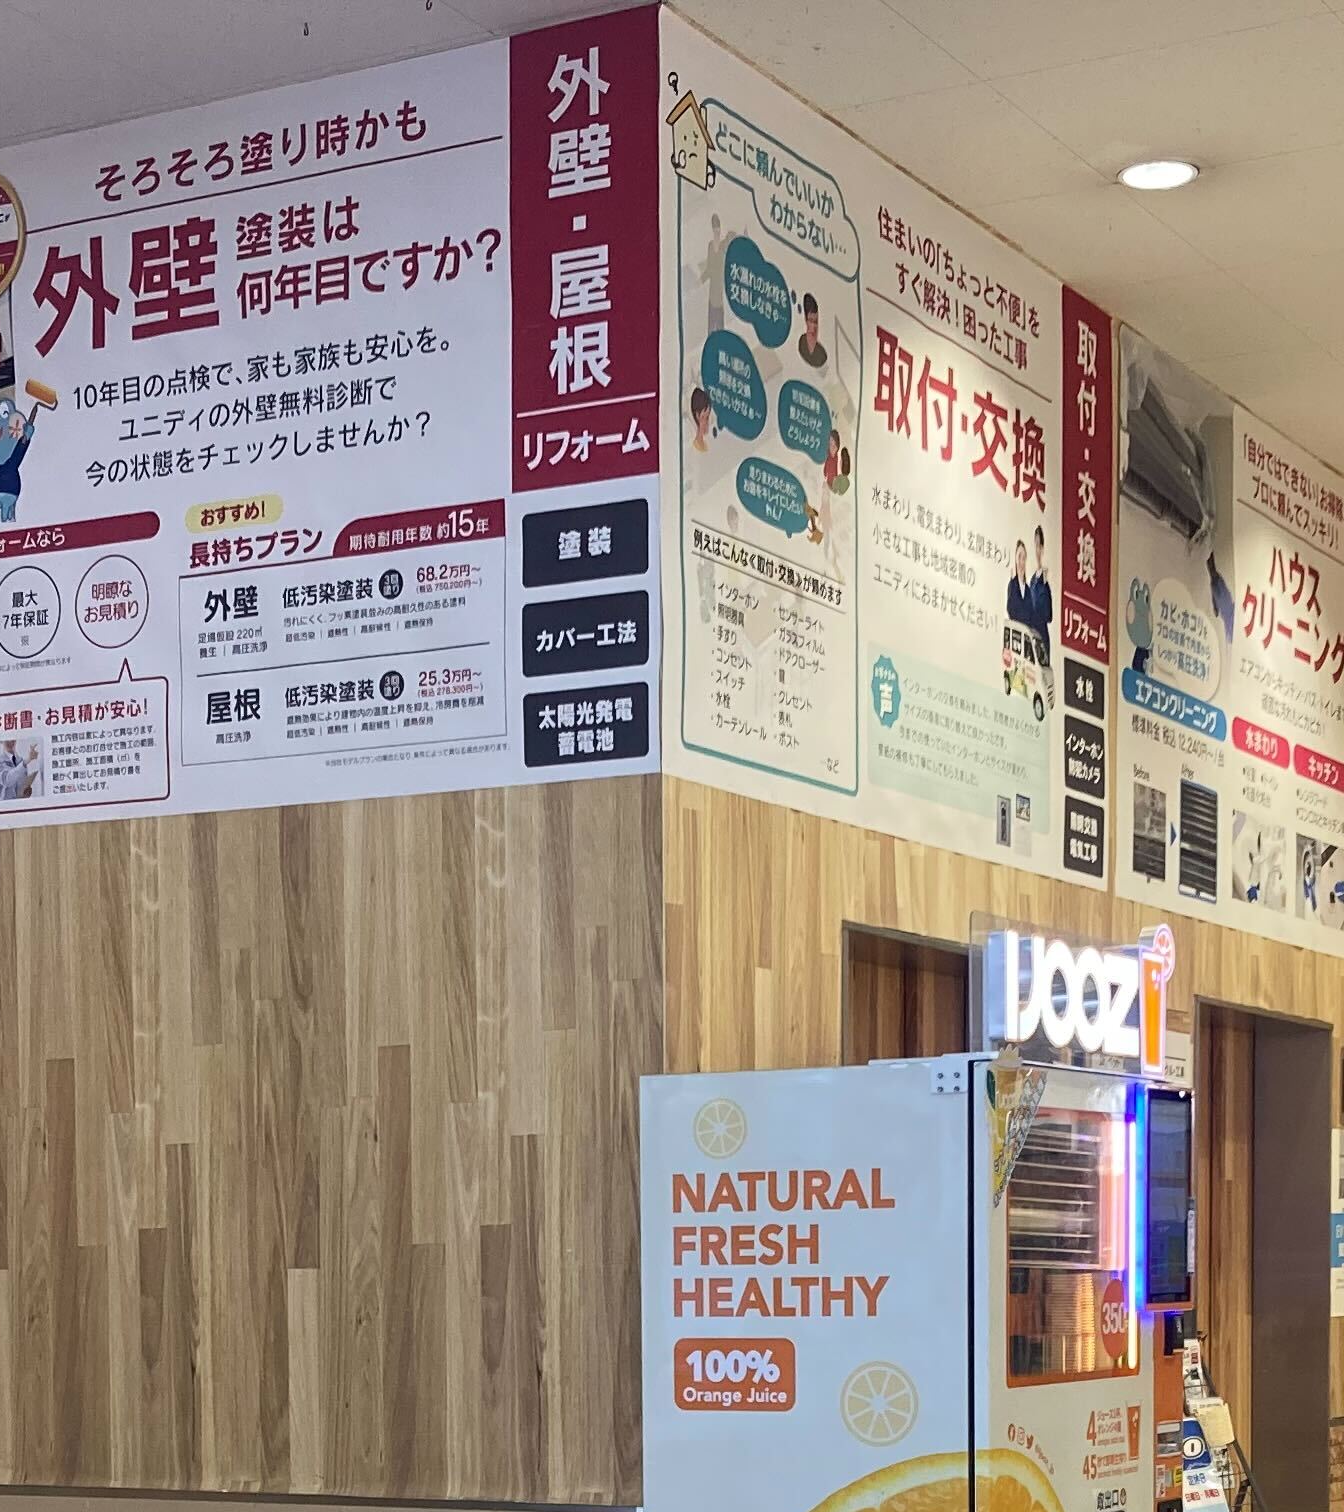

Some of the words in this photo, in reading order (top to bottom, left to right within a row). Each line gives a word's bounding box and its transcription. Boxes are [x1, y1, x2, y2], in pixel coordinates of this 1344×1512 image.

[96, 101, 428, 202] そろそろ塗り時かも
[715, 121, 834, 221] どこに頼んでいいか
[236, 195, 363, 261] 塗装は
[544, 52, 614, 396] 外壁・屋根
[31, 218, 219, 358] 外壁
[236, 228, 502, 321] 何年目ですか?
[877, 204, 1040, 339] 住まいの「ちょっと不便」を
[72, 330, 454, 412] 10年目の点検で、家も家族も安心を。
[120, 376, 398, 443] ユニディの外壁無料診断で
[873, 325, 1047, 513] 取付・交換
[86, 412, 433, 489] 今の状態をチェックしませんか?
[522, 418, 652, 472] リフォーム
[1075, 318, 1098, 588] 取付・交換
[189, 527, 324, 570] 長持ちプラン
[349, 524, 434, 551] 期待耐用年数
[436, 508, 490, 541] 約15年
[557, 526, 612, 561] 塗装
[10, 590, 39, 608] 最大
[282, 576, 375, 610] 低汚染塗装
[1269, 547, 1321, 617] ハウス
[2, 608, 51, 630] 7年保証
[83, 599, 141, 625] お見積り
[203, 585, 259, 624] 外壁
[535, 621, 638, 653] カバー工法
[1063, 605, 1107, 652] リフォーム
[206, 688, 261, 726] 屋根
[284, 678, 375, 709] 低汚染塗装
[538, 696, 634, 731] 太陽光発電
[1135, 678, 1218, 734] エアコンクリーニング
[557, 728, 616, 757] 蓄電池
[1245, 724, 1279, 760] 水まわり
[1308, 754, 1341, 786] キッチン
[672, 1167, 896, 1214] NATURAL
[672, 1224, 820, 1267] FRESH
[673, 1275, 891, 1319] HEALTHY
[685, 1349, 781, 1385] 100%
[682, 1387, 743, 1406] Orange
[746, 1387, 788, 1404] Juice
[1086, 1411, 1097, 1447] 4
[1082, 1454, 1097, 1480] 45
